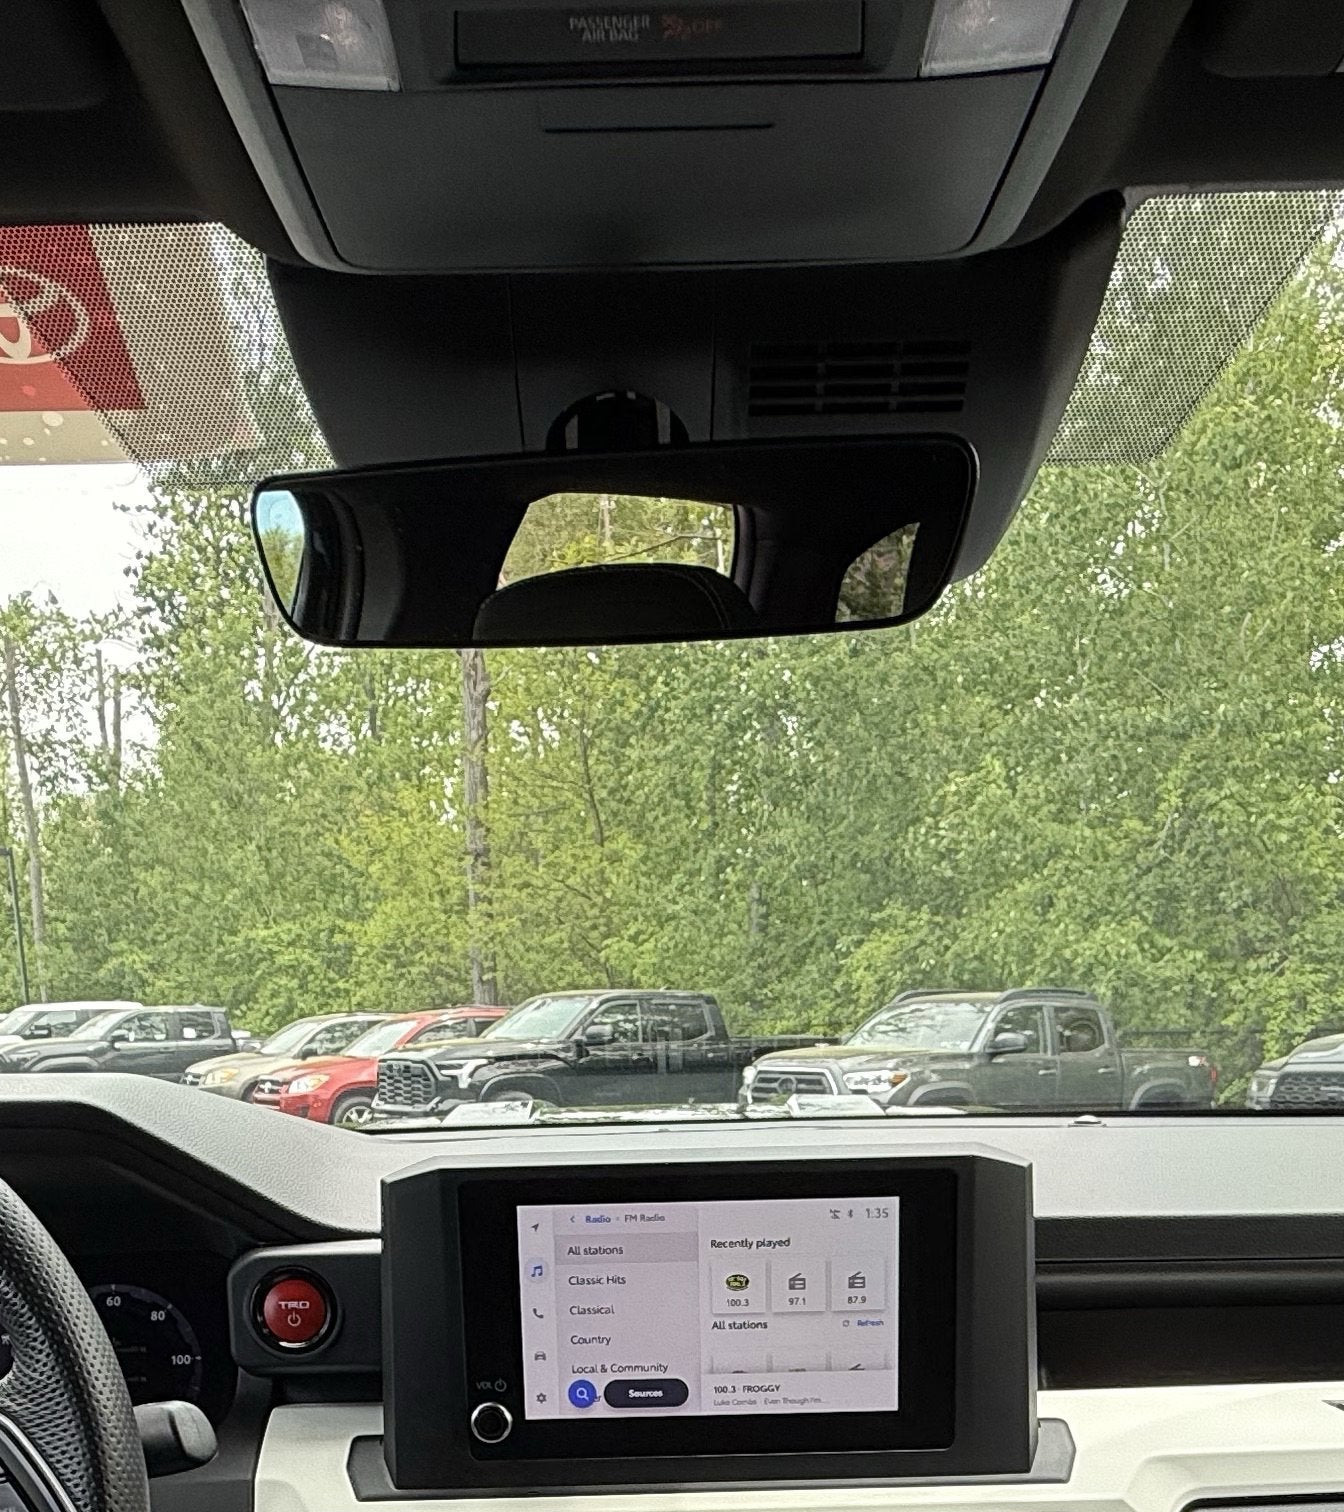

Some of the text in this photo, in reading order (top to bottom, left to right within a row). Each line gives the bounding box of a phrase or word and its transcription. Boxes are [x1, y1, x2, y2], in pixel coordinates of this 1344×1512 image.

[569, 14, 650, 31] PASSENGER
[582, 28, 639, 42] AIR BAG
[585, 1213, 665, 1224] Radio FM Radio
[710, 1237, 791, 1249] Recently played
[567, 1245, 624, 1256] All stations
[568, 1275, 627, 1286] Classic Hits
[106, 1296, 122, 1307] 60
[278, 1300, 310, 1310] TRD
[726, 1298, 750, 1307] 100.3
[788, 1297, 807, 1306] 97.1
[847, 1296, 867, 1305] 87.9
[569, 1304, 615, 1316] Classical
[150, 1311, 166, 1321] 80
[712, 1320, 768, 1330] All stations
[570, 1335, 612, 1346] Country
[171, 1355, 191, 1365] 100
[571, 1362, 669, 1375] Local & Community
[628, 1389, 664, 1399] Sources
[713, 1384, 781, 1394] 100.3 FROGGY
